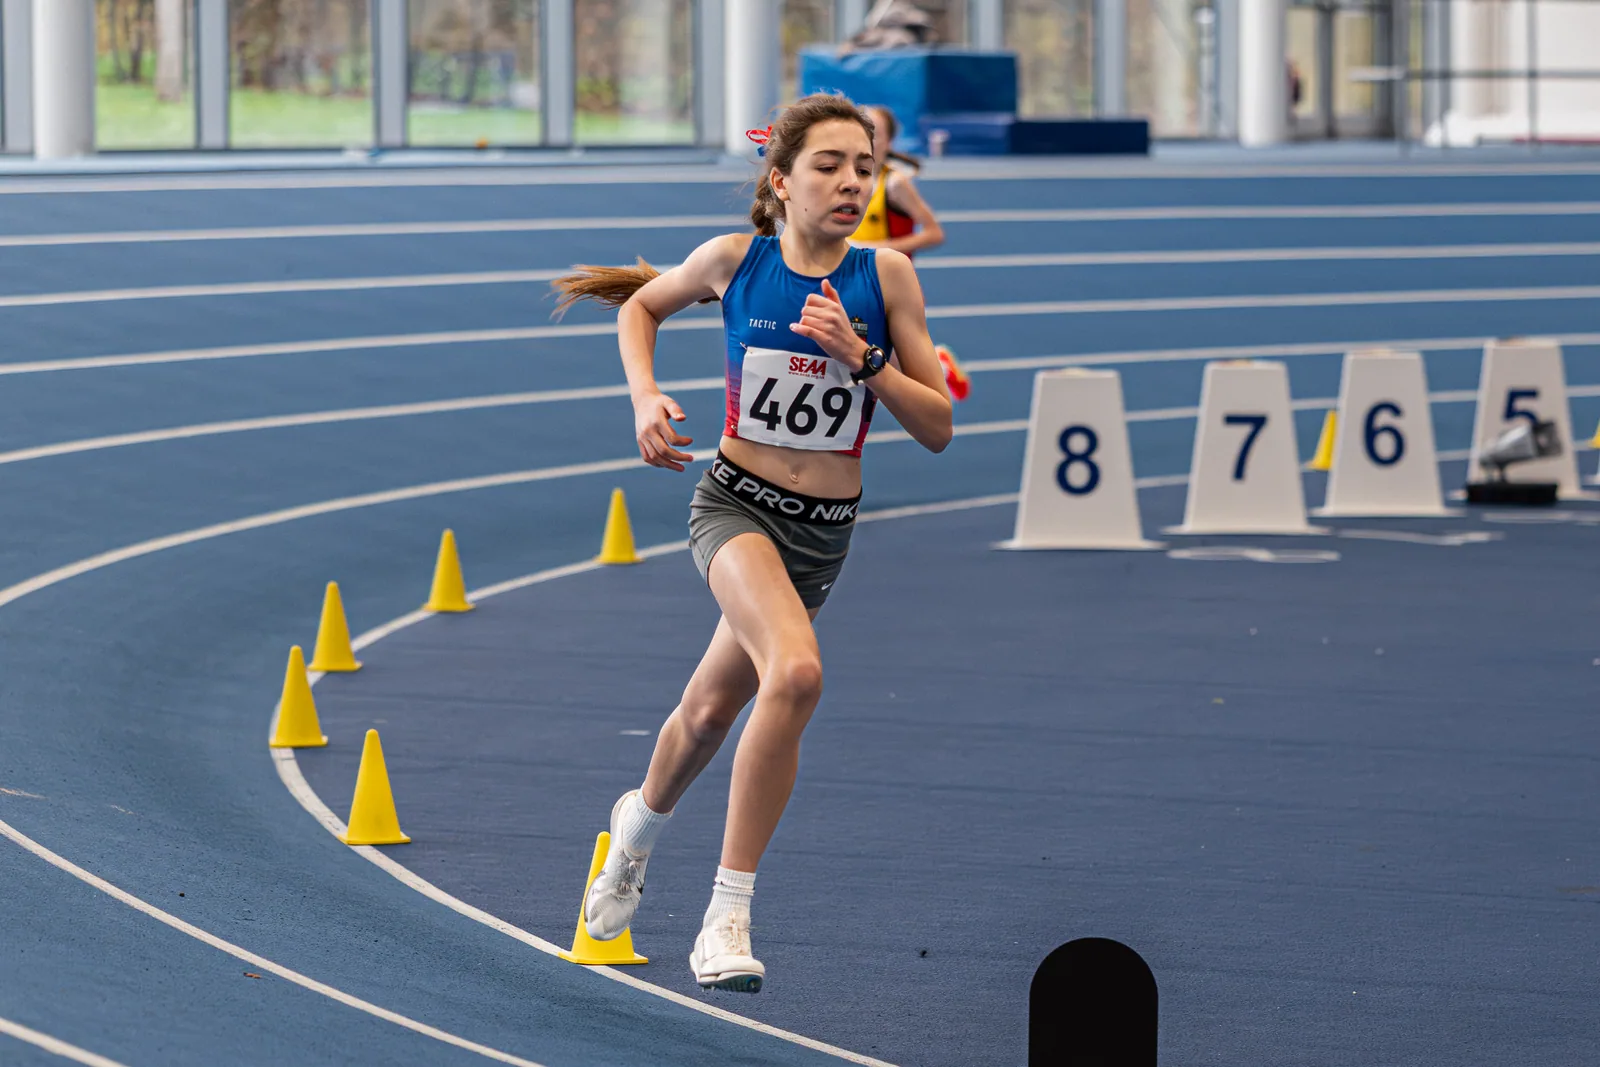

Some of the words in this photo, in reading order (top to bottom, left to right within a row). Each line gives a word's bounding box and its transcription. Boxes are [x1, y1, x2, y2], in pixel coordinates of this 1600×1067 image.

[749, 318, 777, 330] TACTIC
[788, 356, 827, 375] SEAA
[749, 377, 853, 438] 469
[1362, 401, 1405, 467] 6
[1055, 425, 1101, 496] 8
[1223, 414, 1268, 482] 7
[735, 476, 805, 514] PRO
